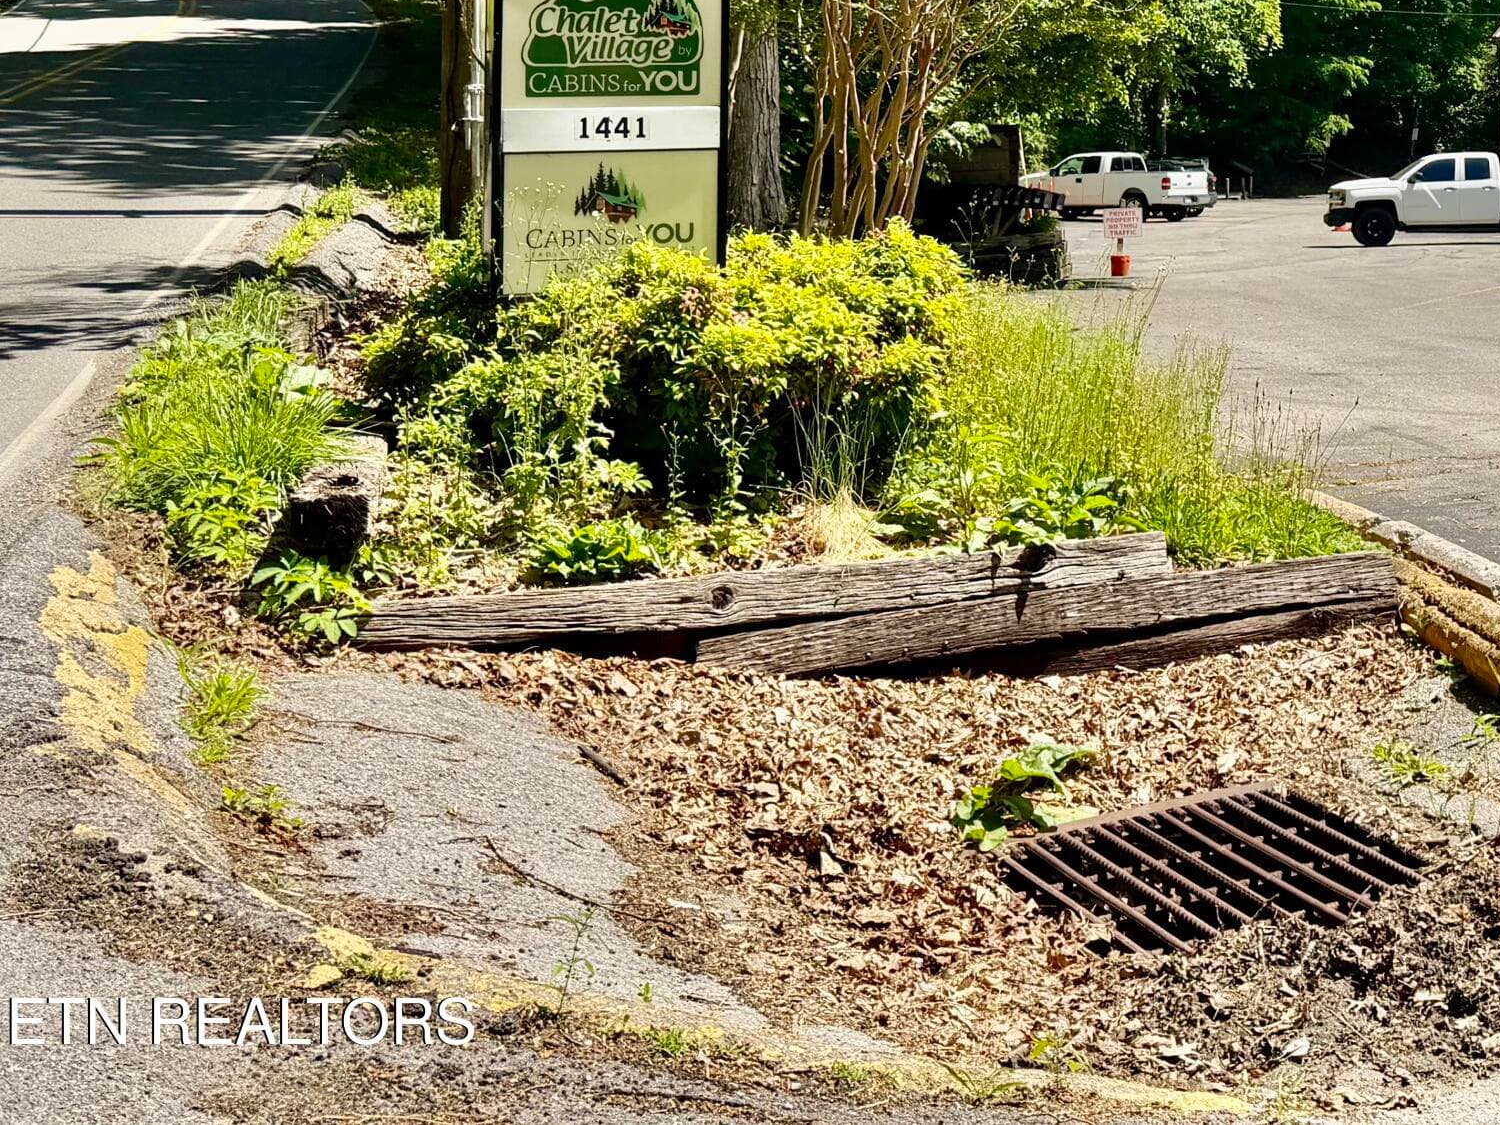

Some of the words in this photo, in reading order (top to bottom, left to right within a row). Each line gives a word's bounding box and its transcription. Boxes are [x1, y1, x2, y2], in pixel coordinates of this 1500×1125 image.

[535, 6, 638, 35] Chalet
[565, 35, 672, 65] Village
[678, 45, 692, 56] by
[529, 72, 621, 93] CABINS
[623, 80, 642, 92] for
[638, 70, 698, 92] YOU
[579, 116, 647, 139] 1441
